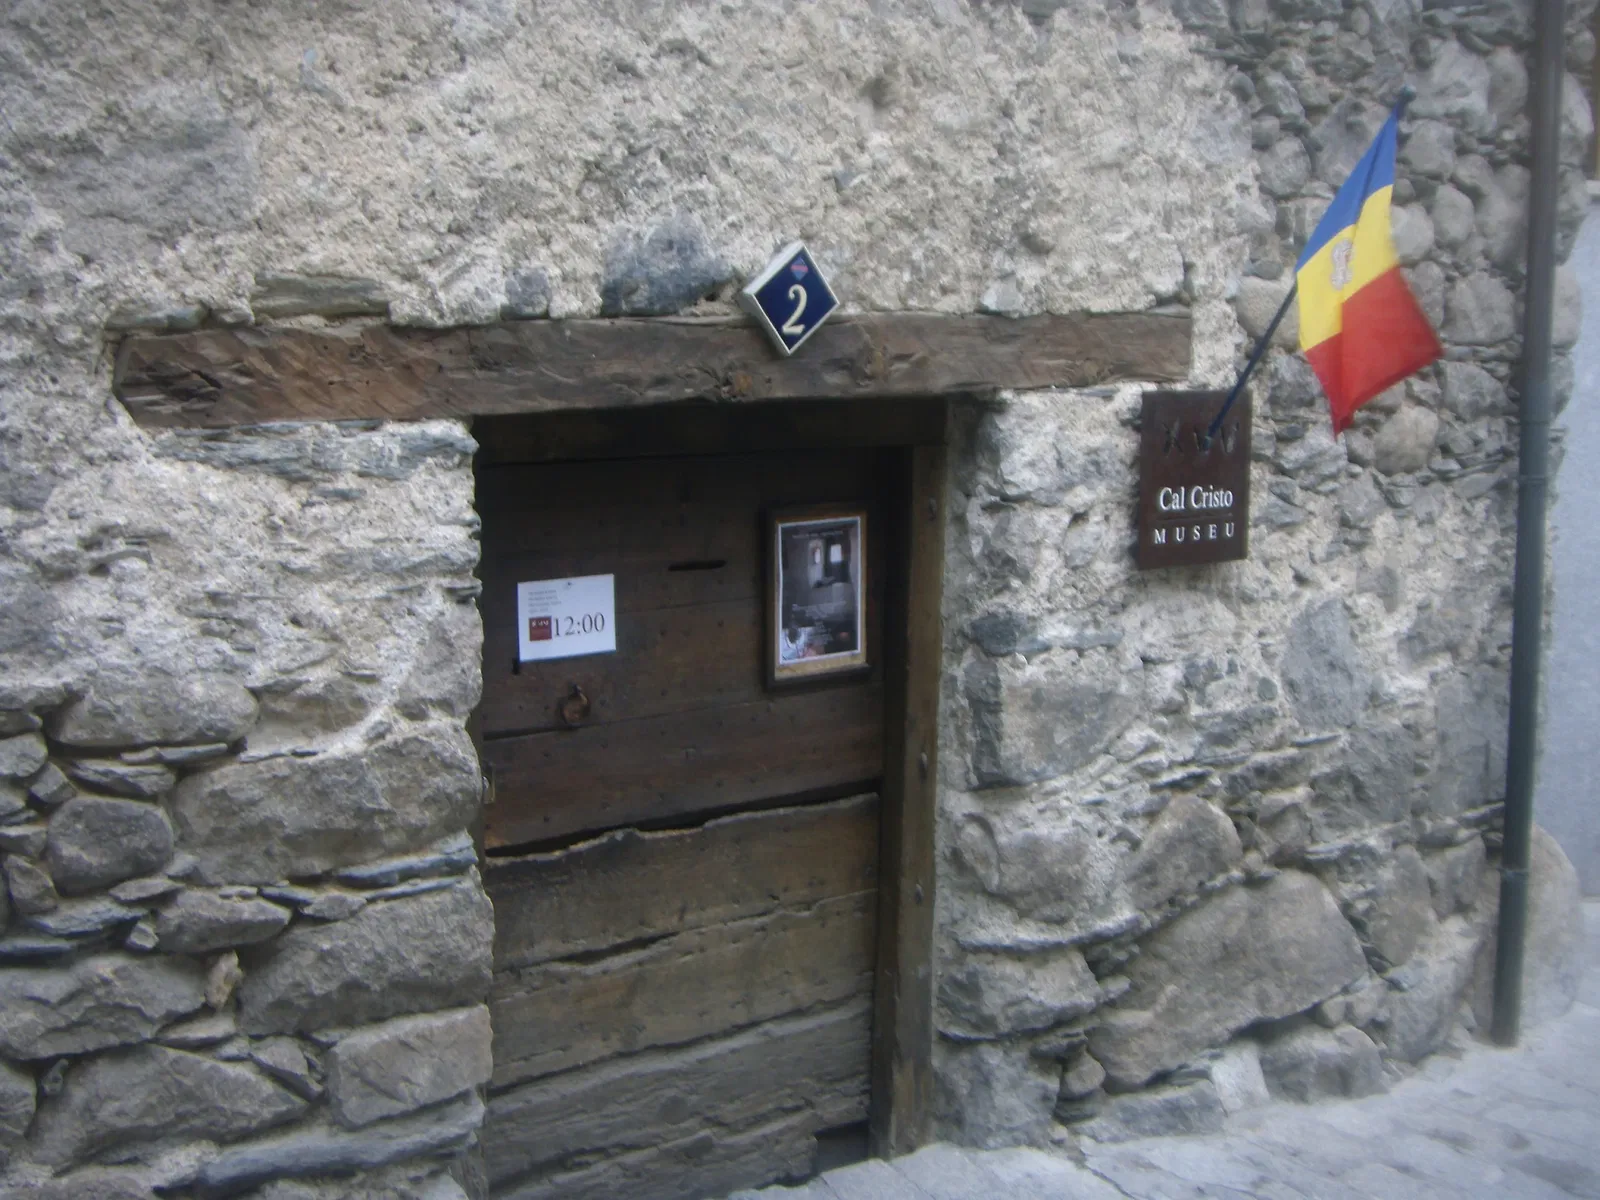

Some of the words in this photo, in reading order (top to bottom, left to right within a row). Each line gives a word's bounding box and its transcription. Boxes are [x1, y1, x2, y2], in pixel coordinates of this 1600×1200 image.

[782, 284, 808, 335] 2
[1159, 486, 1185, 511] Cal
[1191, 484, 1234, 509] Cristo
[1154, 522, 1235, 544] MUSEU
[554, 612, 605, 637] 12:00
